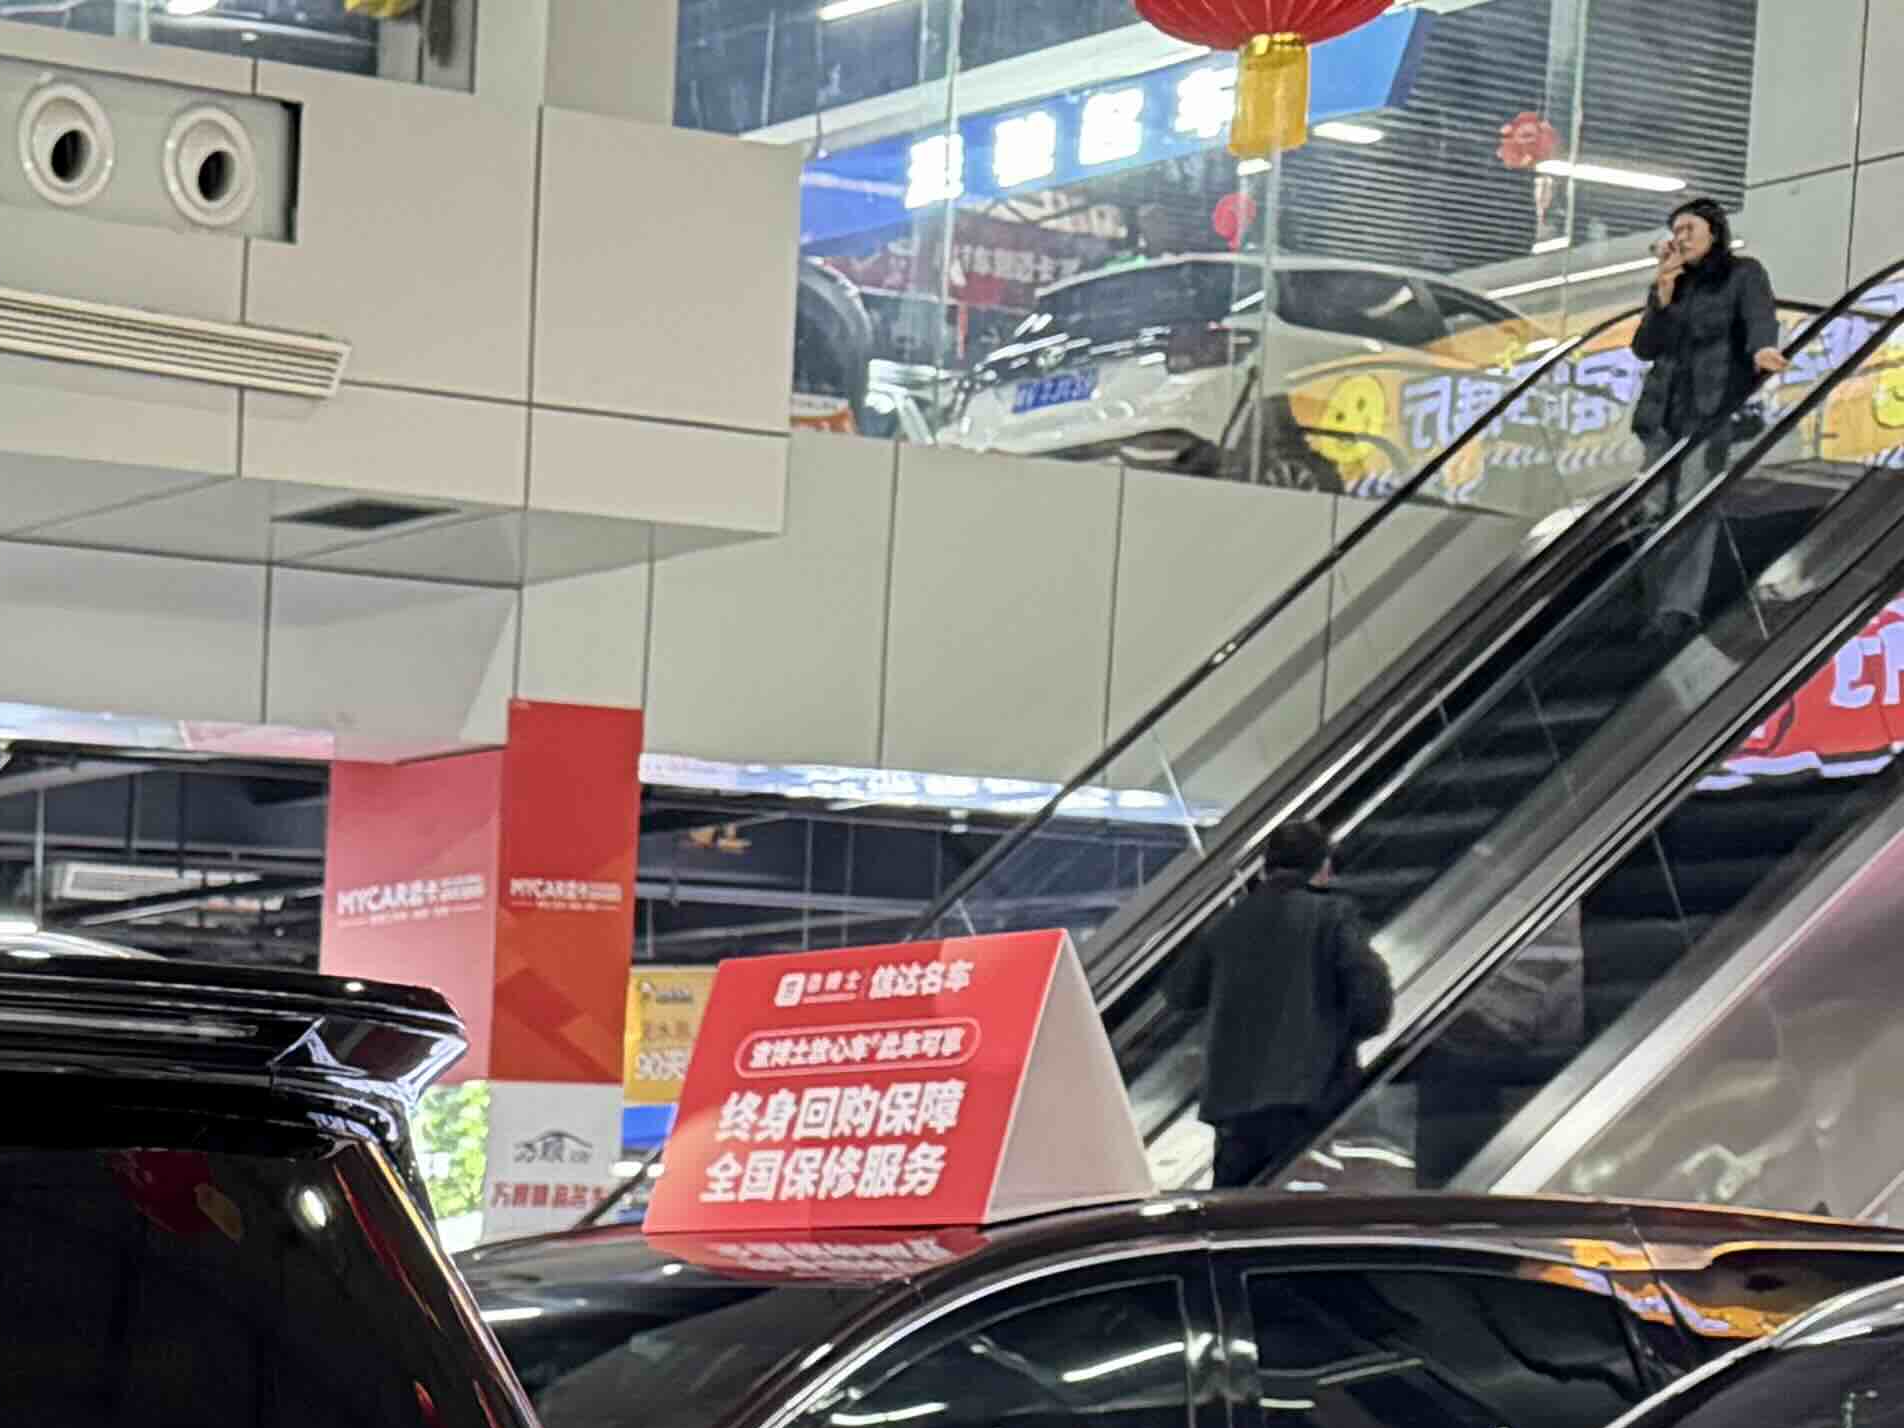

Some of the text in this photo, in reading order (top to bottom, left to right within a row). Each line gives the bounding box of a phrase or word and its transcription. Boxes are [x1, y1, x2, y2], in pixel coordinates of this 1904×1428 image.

[869, 960, 974, 1000] 信达名车
[714, 1079, 967, 1146] 终身回购保障
[699, 1141, 949, 1204] 全国保修服务
